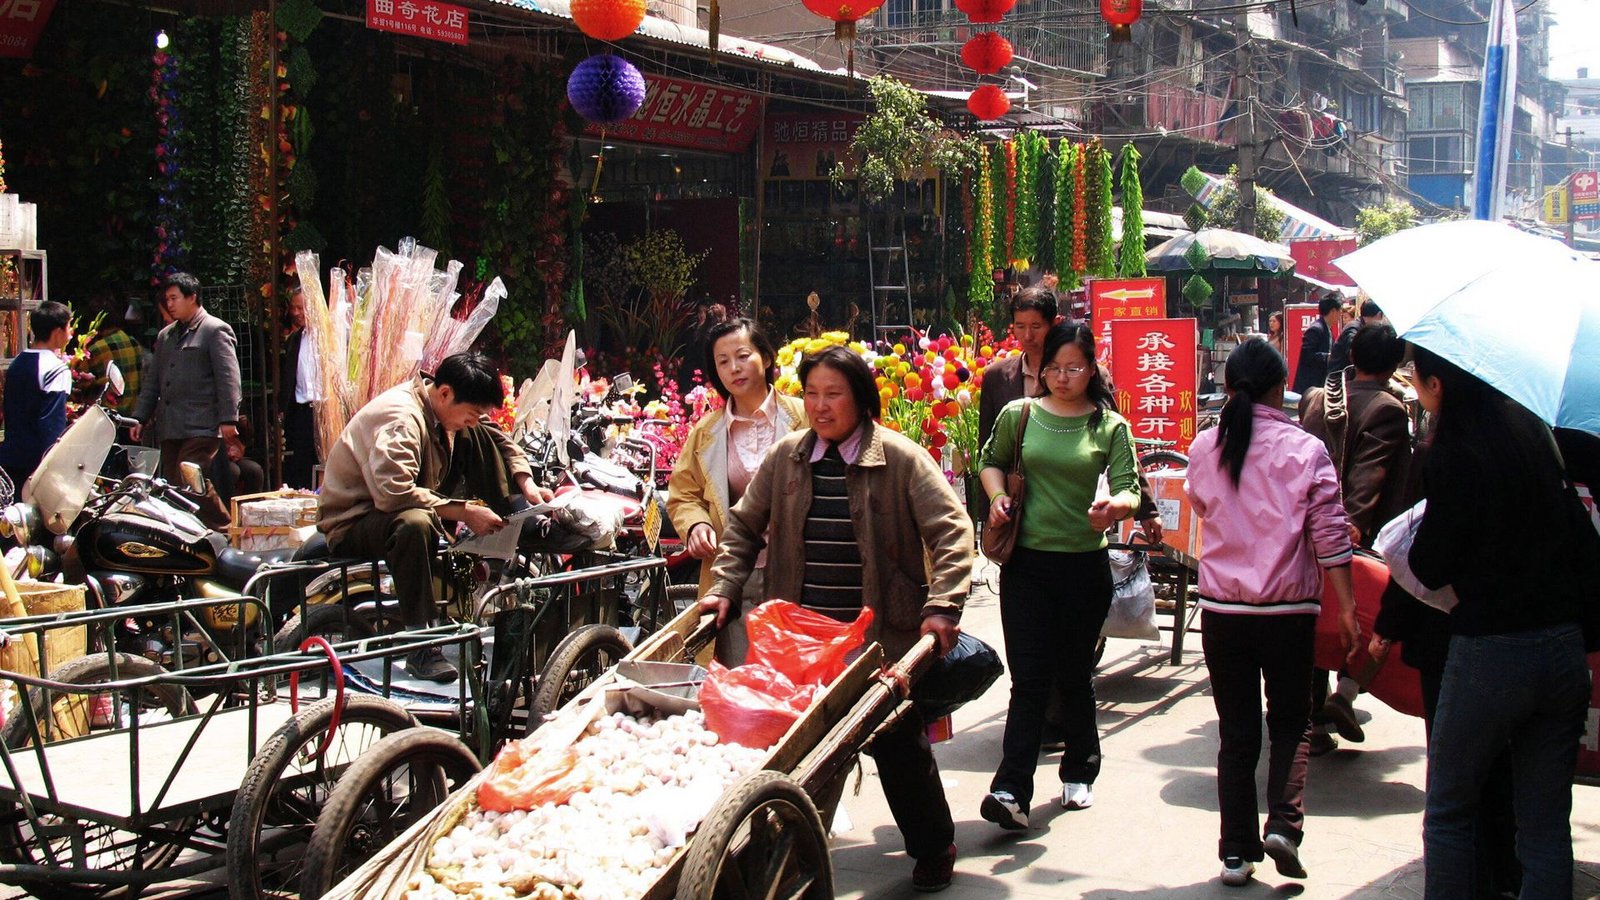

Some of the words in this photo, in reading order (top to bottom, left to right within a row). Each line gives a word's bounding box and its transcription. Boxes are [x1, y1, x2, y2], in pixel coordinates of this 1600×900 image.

[375, 0, 465, 29] 曲奇花店
[774, 120, 865, 142] 驰恒精品
[1097, 306, 1158, 317] 厂家直销
[1136, 332, 1176, 472] 承接各种开
